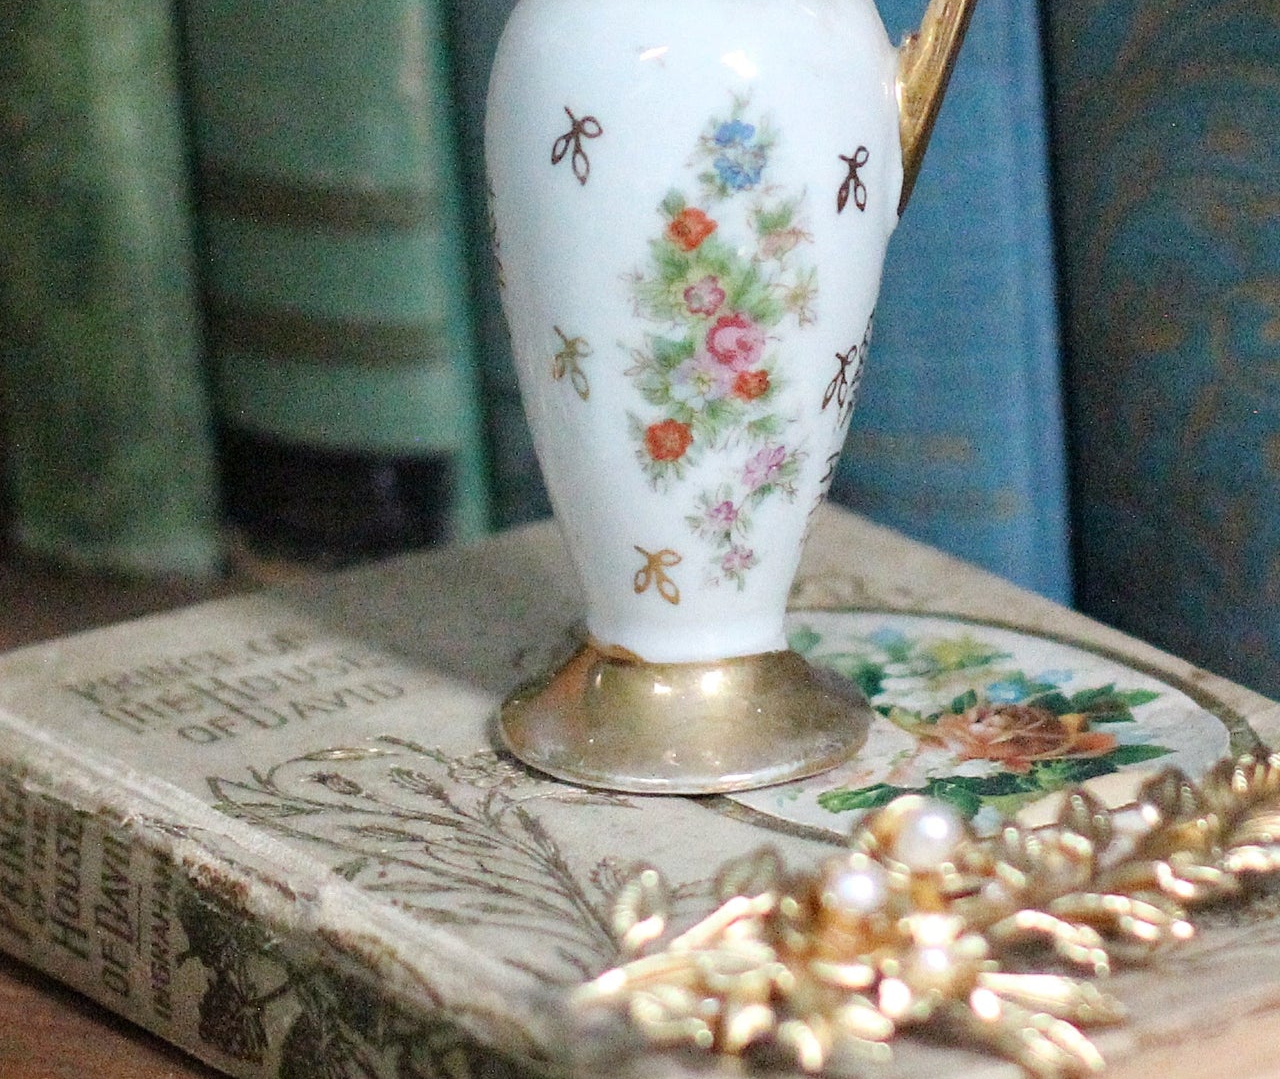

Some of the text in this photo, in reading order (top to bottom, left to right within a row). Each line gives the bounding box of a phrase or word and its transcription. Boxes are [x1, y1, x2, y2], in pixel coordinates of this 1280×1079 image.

[176, 716, 238, 745] OF
[49, 814, 90, 962] HOUSE
[99, 938, 131, 998] OF
